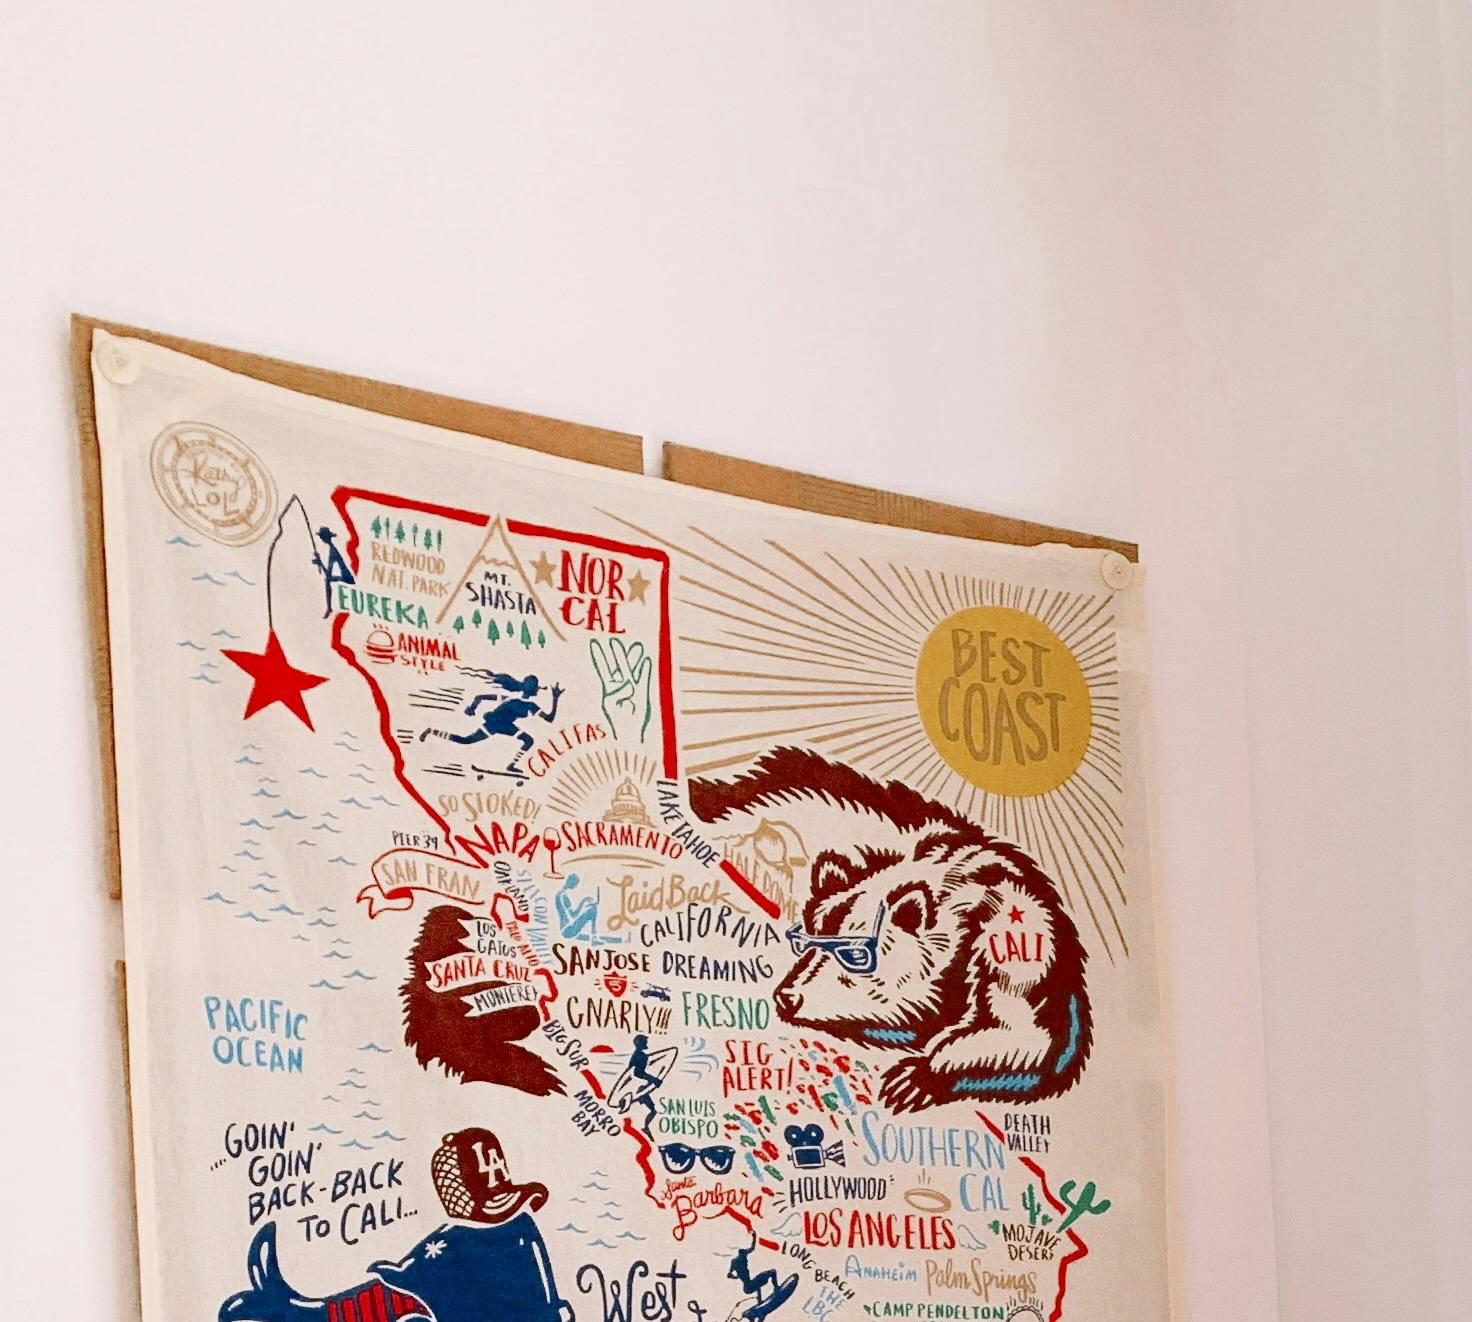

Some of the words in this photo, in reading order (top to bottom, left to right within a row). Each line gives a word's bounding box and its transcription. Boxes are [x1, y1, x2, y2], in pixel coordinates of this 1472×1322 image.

[371, 541, 446, 575] REDWOOD
[557, 550, 625, 601] NOR
[412, 576, 451, 597] PARK
[484, 570, 511, 586] MT.
[337, 585, 428, 630] EUREKA
[465, 581, 537, 615] SHASTA
[558, 597, 626, 634] CAL
[396, 632, 461, 661] ANIMAL
[400, 654, 446, 672] STYLE
[951, 628, 1051, 687] BEST
[938, 676, 1066, 766] COAST
[528, 723, 607, 777] CALIFAS
[423, 834, 438, 850] 39
[561, 821, 683, 860] SACRAMENTO
[656, 780, 684, 825] LAKE
[671, 821, 721, 868] TAHOE
[454, 821, 541, 868] NAPA
[722, 842, 761, 881] HALF
[381, 858, 418, 887] SAN
[425, 861, 481, 900] FRAN
[493, 860, 530, 912] OAKLAND
[606, 874, 664, 931] Laid
[666, 873, 750, 914] Back
[476, 921, 497, 937] LOS
[640, 902, 782, 948] CALIFORNIA
[477, 938, 517, 958] GATOS
[663, 951, 774, 983] DREAMING
[989, 931, 1045, 965] CALI
[431, 954, 486, 988] SANTA
[493, 959, 531, 983] CRUZ
[204, 995, 308, 1041] PACIFIC
[474, 985, 538, 1012] MONTEREY
[566, 995, 673, 1035] GNARLY!!!
[682, 991, 770, 1031] FRESNO
[212, 1036, 305, 1073] OCEAN
[542, 1019, 568, 1045] BIG
[556, 1039, 590, 1071] SUR
[725, 1039, 773, 1065] SIG
[722, 1057, 794, 1098] ALERT!
[571, 1111, 600, 1137] BAY
[574, 1089, 622, 1138] MORRO
[658, 1097, 689, 1116] SAN
[690, 1098, 716, 1118] LUIS
[1004, 1113, 1051, 1136] DEATH
[658, 1117, 720, 1139] OBISPO
[860, 1110, 1005, 1171] SOUTHERN
[1007, 1134, 1050, 1154] VALLEY
[248, 1142, 322, 1187] GOIN'
[471, 1141, 512, 1188] LA
[249, 1159, 403, 1226] BACK-BACK
[661, 1176, 697, 1201] Santa
[789, 1176, 887, 1208] HOLLYWOOD
[959, 1172, 1011, 1212] CAL
[670, 1183, 764, 1242] Barbara
[803, 1208, 843, 1248] LOS
[849, 1209, 956, 1250] ANGELES
[1002, 1223, 1062, 1250] MOJAVE
[1008, 1244, 1055, 1261] DESERT
[781, 1240, 813, 1270] LONG
[814, 1268, 856, 1300] BEACH
[925, 1260, 971, 1295] Palm
[971, 1257, 1037, 1301] Springs
[819, 1286, 845, 1310] THE
[872, 1302, 914, 1318] CAMP
[917, 1304, 1004, 1320] PENDELTON
